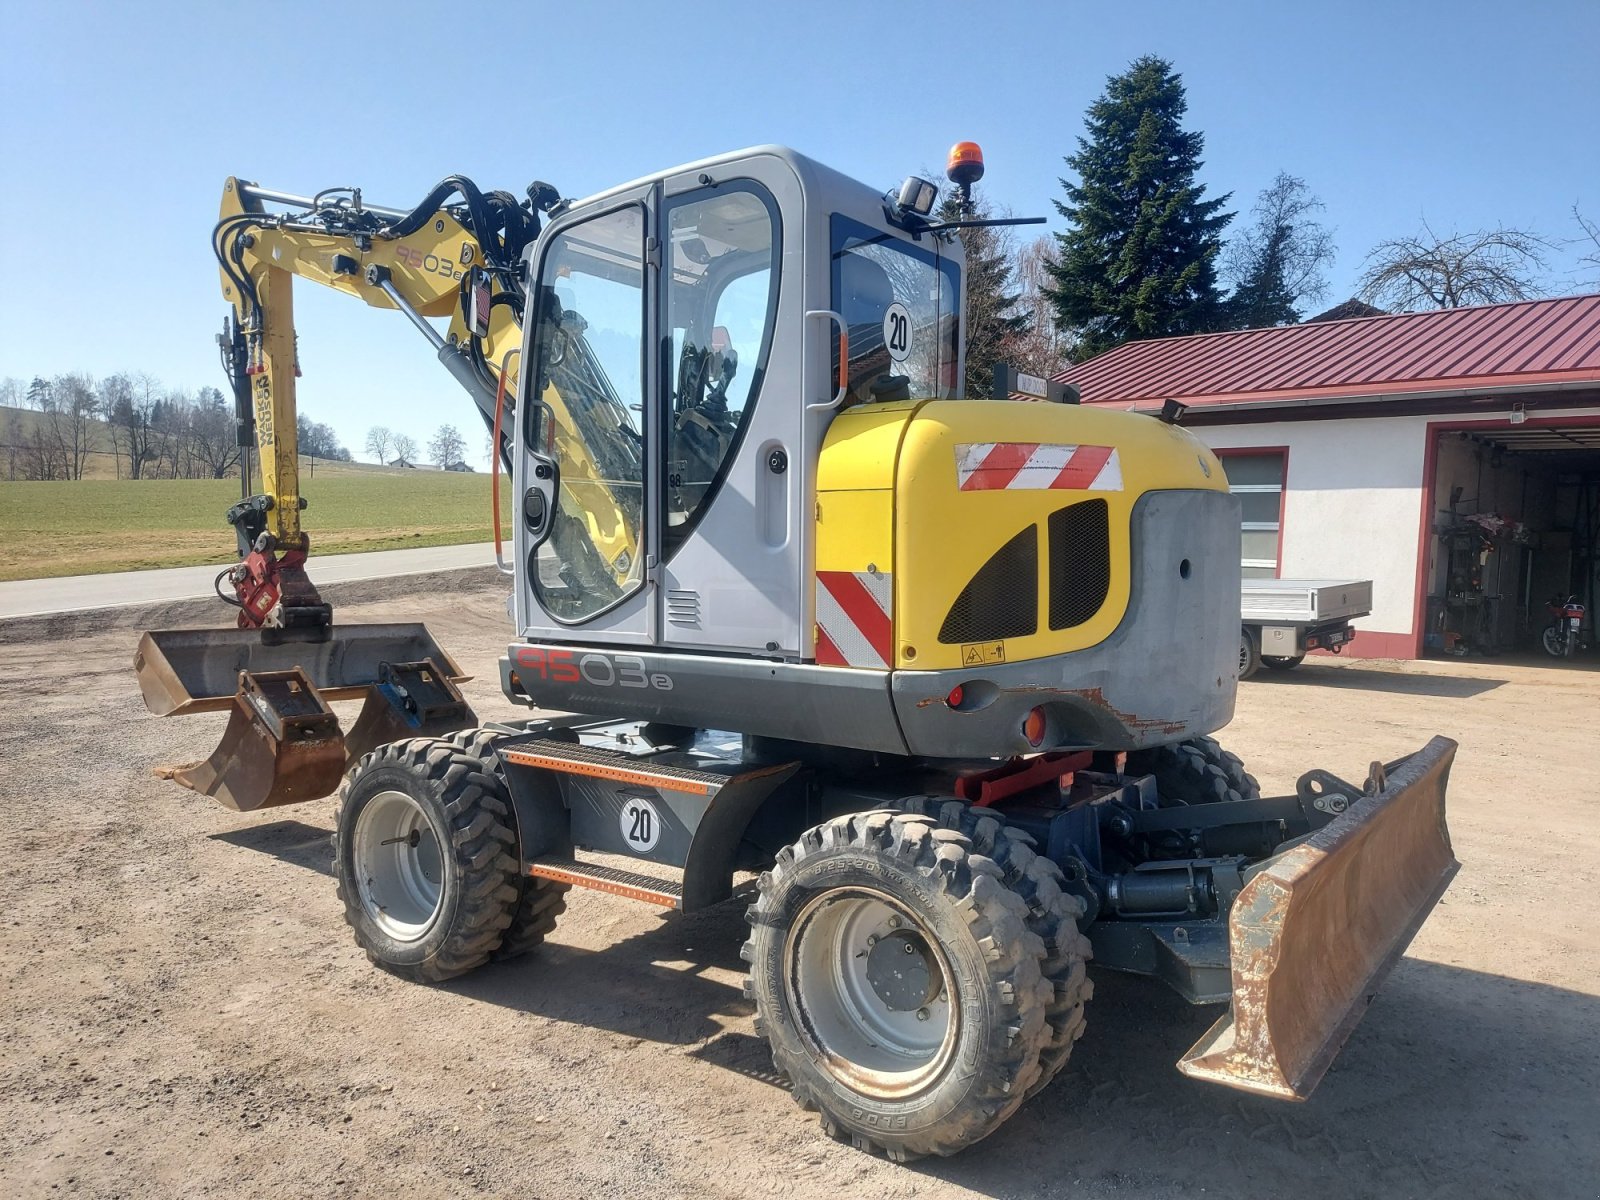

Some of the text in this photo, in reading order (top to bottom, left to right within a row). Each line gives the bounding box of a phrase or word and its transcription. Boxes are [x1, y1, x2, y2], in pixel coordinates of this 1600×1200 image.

[890, 312, 907, 352] 20
[255, 378, 267, 448] WACKER
[263, 374, 273, 446] NEUSON
[629, 806, 651, 844] 20
